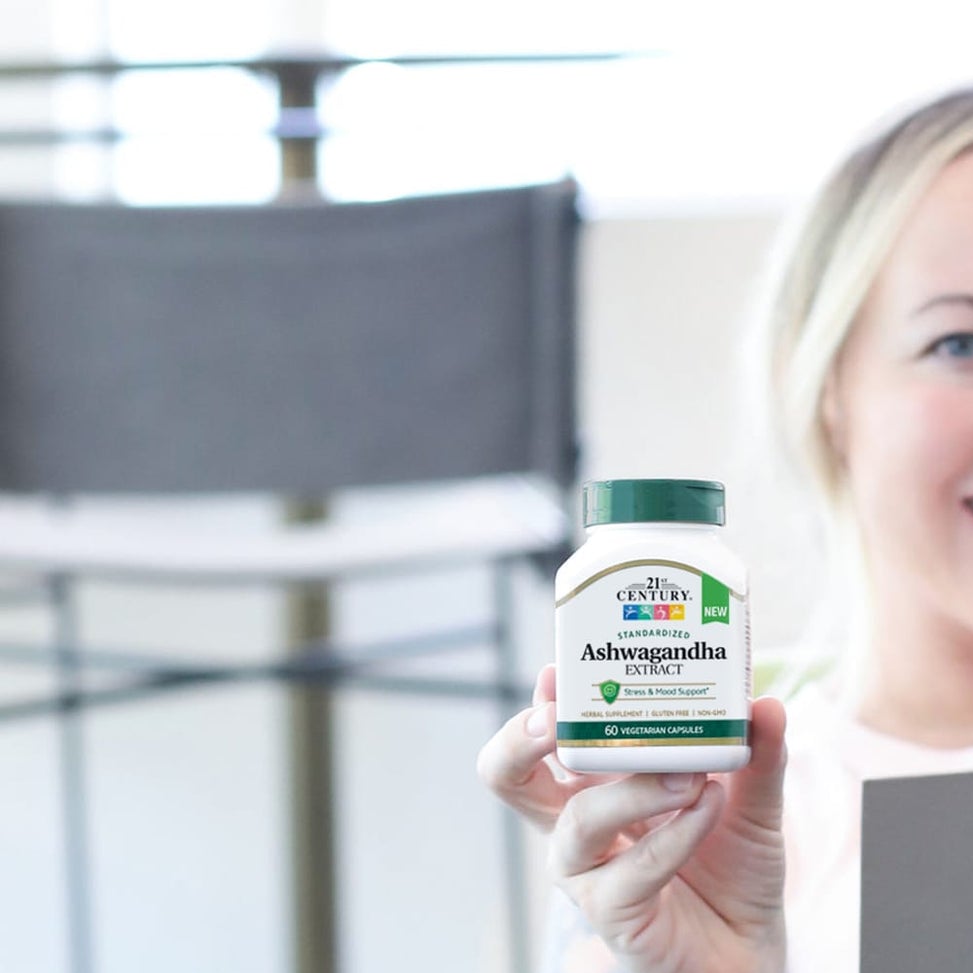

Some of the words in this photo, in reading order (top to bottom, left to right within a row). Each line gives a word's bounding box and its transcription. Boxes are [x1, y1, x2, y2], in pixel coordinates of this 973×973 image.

[704, 606, 728, 617] NEW
[617, 629, 690, 639] STANDARDIZED
[580, 642, 727, 664] Ashwagandha
[625, 664, 684, 676] EXTRACT
[624, 688, 647, 696] Stress
[655, 687, 677, 696] Mood
[604, 725, 618, 736] 60
[621, 727, 666, 735] VEGETARIAN
[667, 726, 704, 735] CAPSULES
